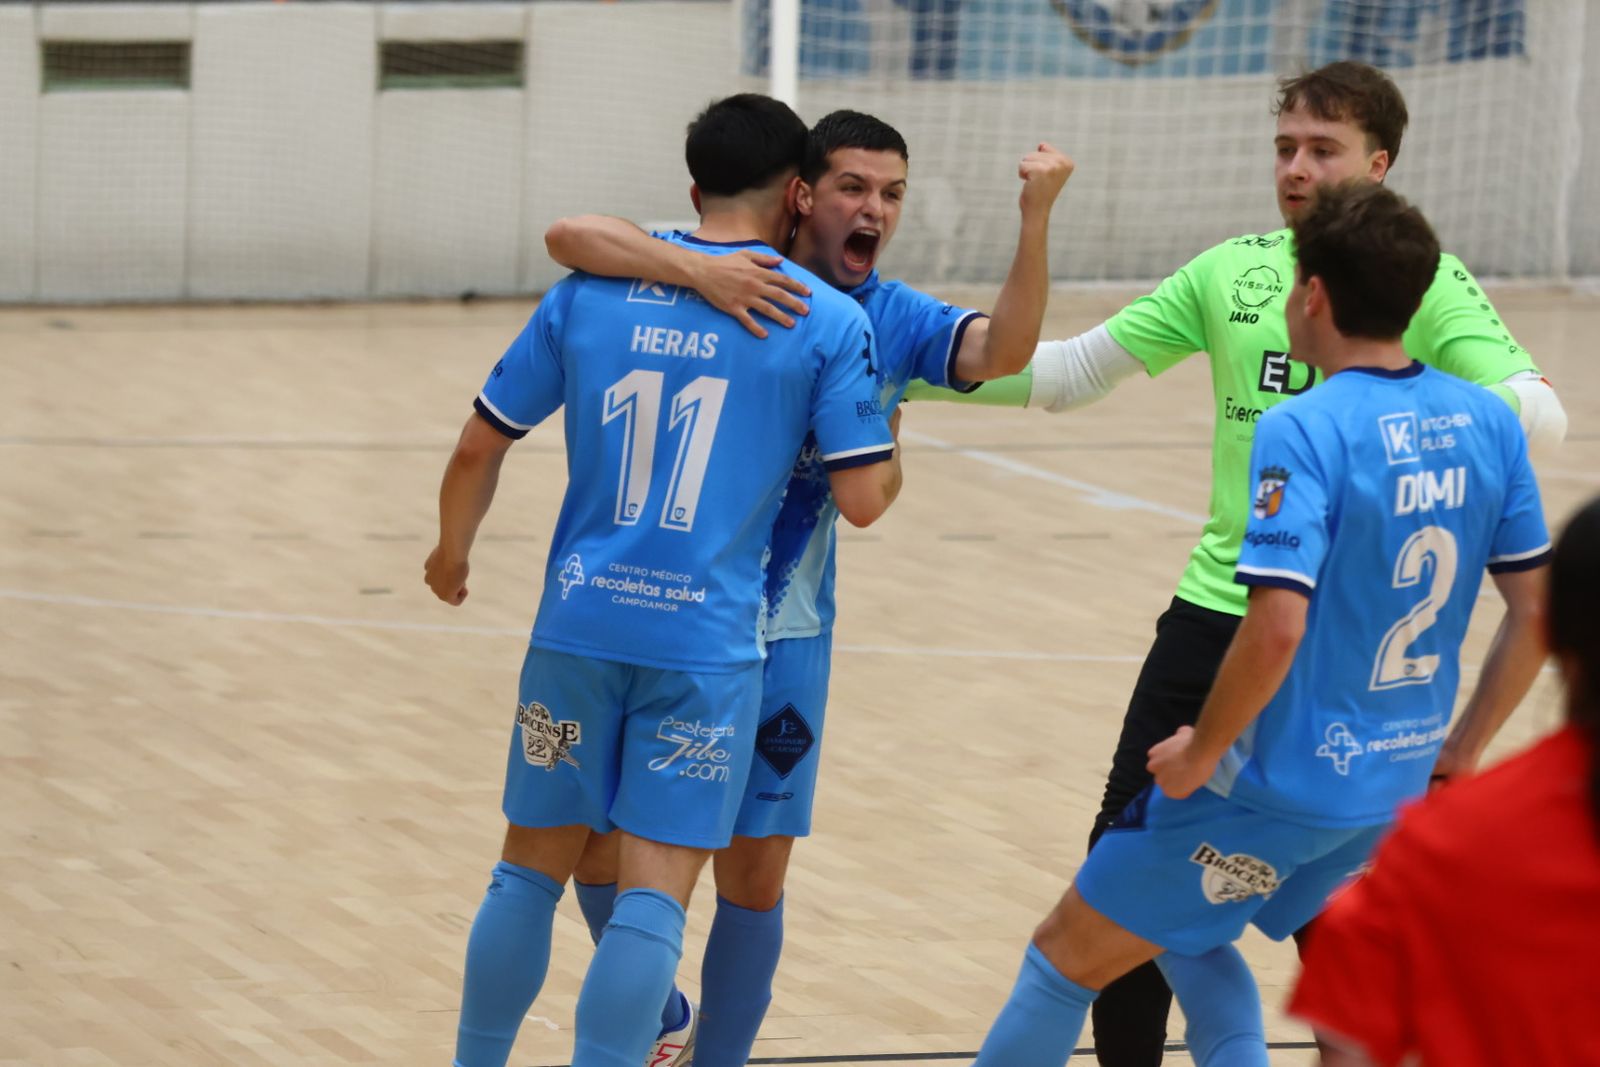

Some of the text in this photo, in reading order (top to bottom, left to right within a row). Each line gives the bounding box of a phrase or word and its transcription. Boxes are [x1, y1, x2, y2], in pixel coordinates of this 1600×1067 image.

[1232, 279, 1284, 294] NISSAN
[1228, 310, 1260, 325] JAKO
[630, 325, 719, 359] HERAS
[1225, 397, 1270, 424] Ener
[602, 369, 729, 533] 11
[1421, 433, 1456, 451] PLUS
[1393, 466, 1466, 517] DOMI
[608, 562, 692, 584] CENTRO MÉDICO
[591, 574, 706, 603] recoletas salud
[611, 594, 679, 613] CAMPOAMOR
[1368, 525, 1458, 691] 2
[679, 763, 730, 783] .com
[1193, 845, 1278, 890] BROCEN
